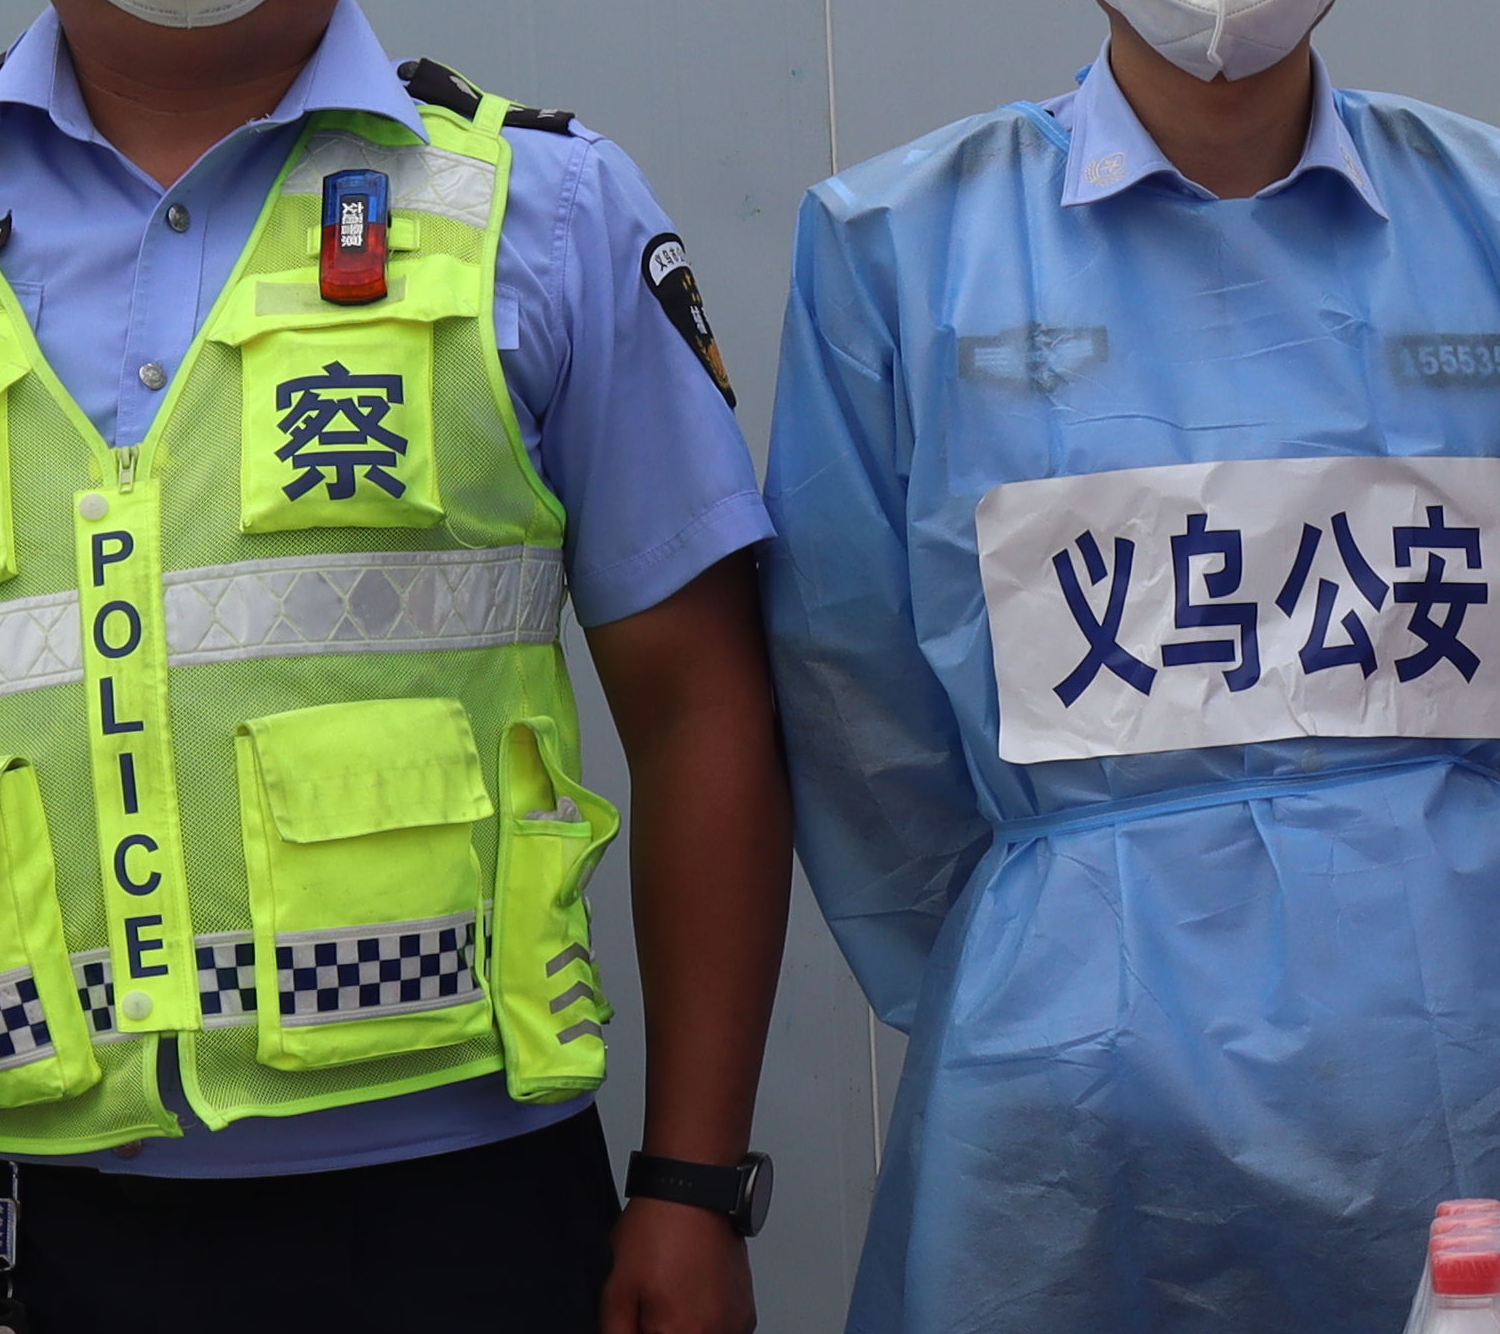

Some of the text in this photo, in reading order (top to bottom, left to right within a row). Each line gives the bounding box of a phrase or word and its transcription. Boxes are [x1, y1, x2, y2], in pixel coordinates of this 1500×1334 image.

[275, 361, 409, 503] 察
[1051, 504, 1489, 711] 义乌公安
[91, 529, 169, 980] POLICE
